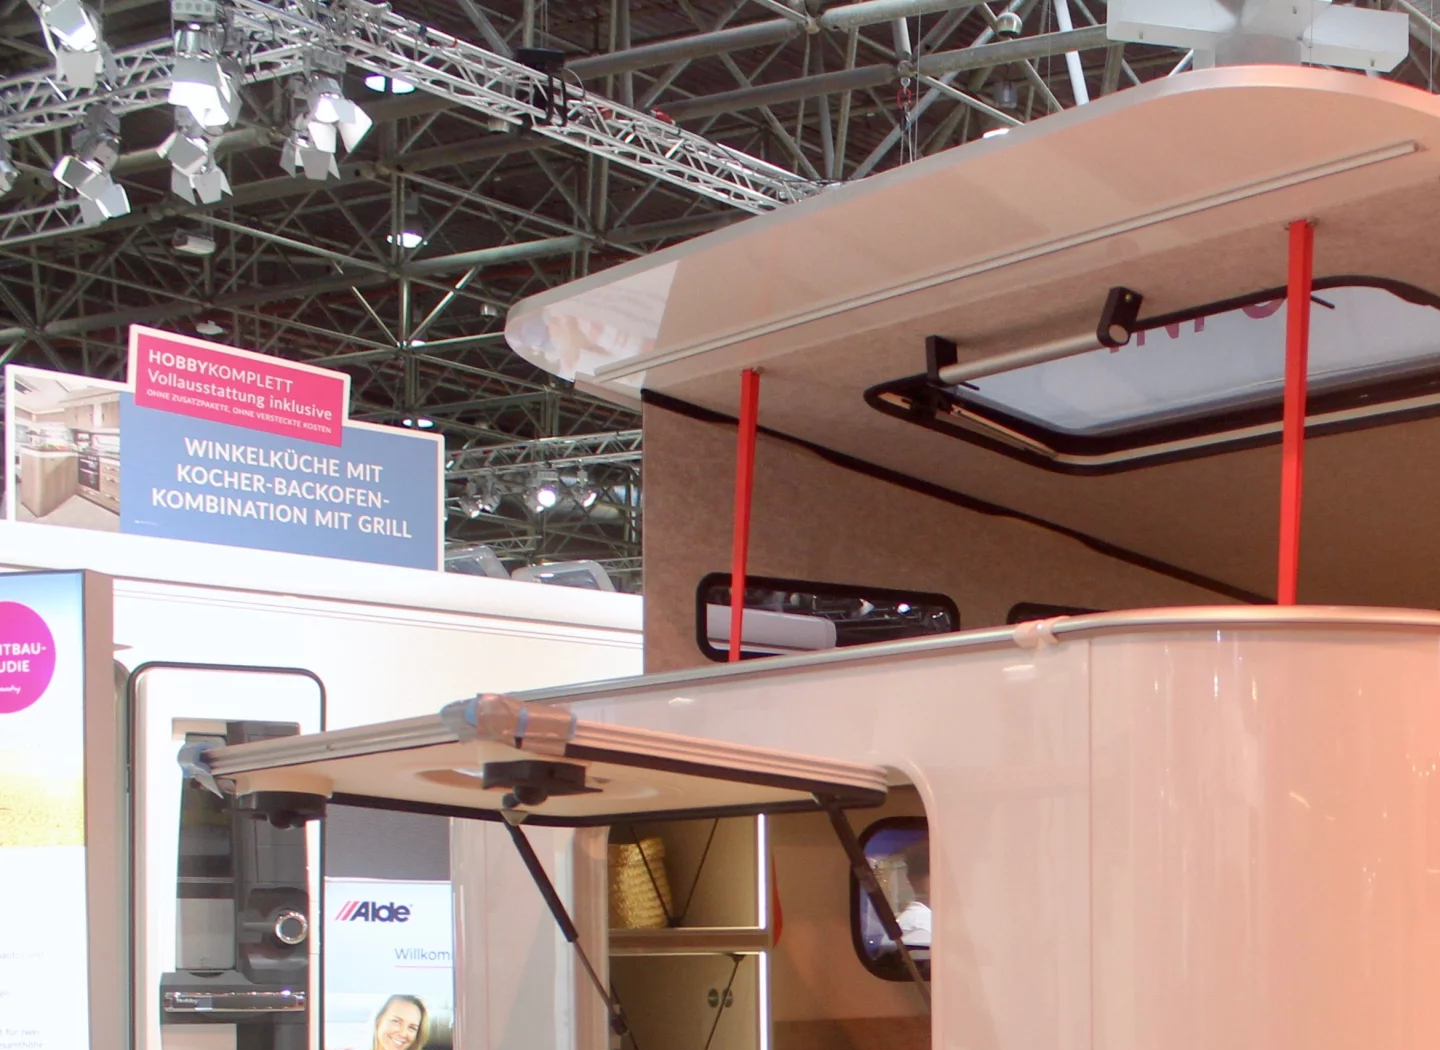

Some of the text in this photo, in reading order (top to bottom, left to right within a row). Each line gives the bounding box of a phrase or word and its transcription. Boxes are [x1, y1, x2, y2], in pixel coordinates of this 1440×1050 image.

[149, 349, 293, 393] HOBBYKOMPLETT
[146, 389, 170, 401] OHNE
[232, 407, 254, 418] OHNE
[256, 410, 301, 428] VERSTECKTE
[303, 421, 331, 434] KOSTEN
[148, 368, 332, 421] Vollausstattung inklusive
[184, 437, 383, 483] WINKELKÜCHE MIT
[177, 463, 390, 509] KOCHER-BACKOFEN-
[152, 488, 412, 538] KOMBINATION MIT GRILL
[349, 901, 411, 922] Alde
